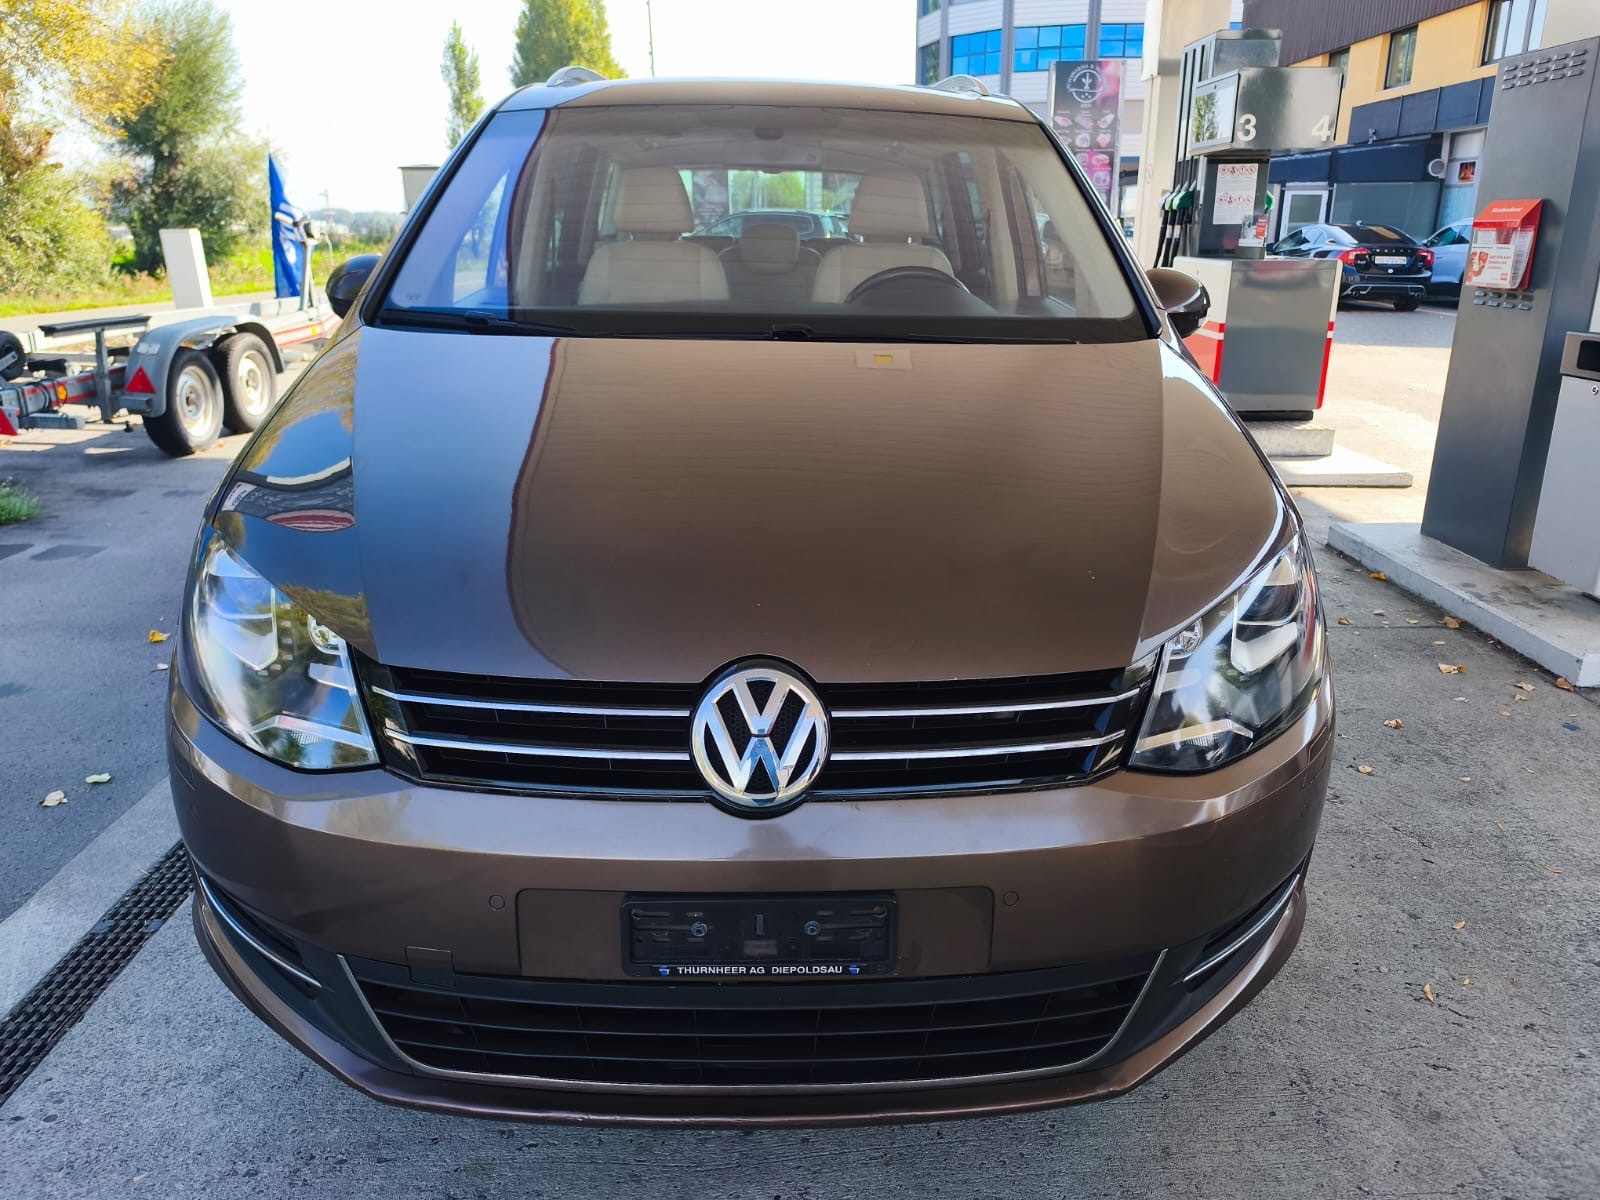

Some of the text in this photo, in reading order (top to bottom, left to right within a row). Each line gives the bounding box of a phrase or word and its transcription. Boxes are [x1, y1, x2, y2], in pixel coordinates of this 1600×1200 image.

[1238, 113, 1257, 142] 3
[1311, 114, 1332, 142] 4
[696, 671, 826, 804] VW
[677, 965, 843, 975] THURNHEER AG DIEPOLDSAU
